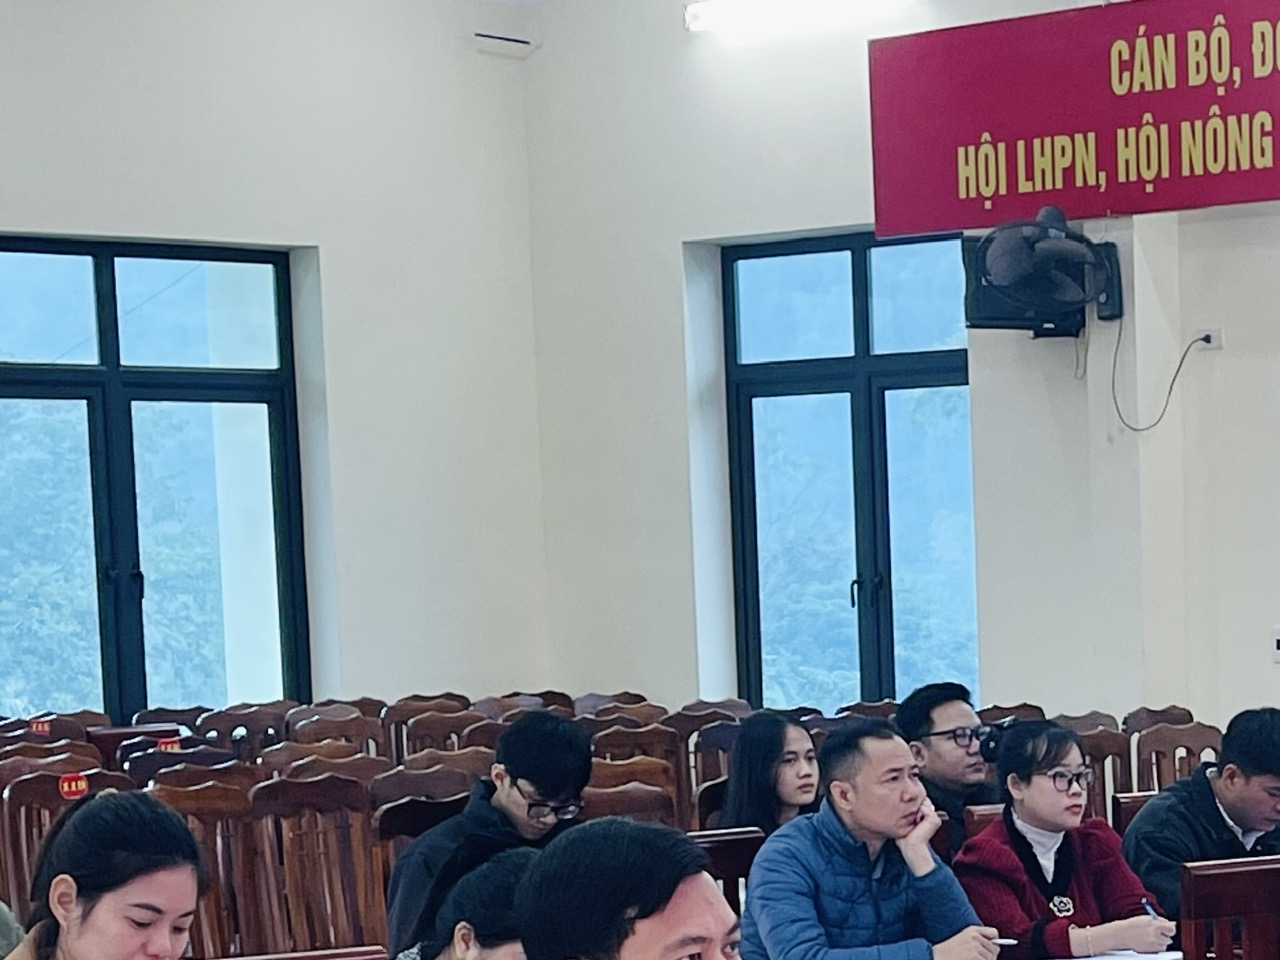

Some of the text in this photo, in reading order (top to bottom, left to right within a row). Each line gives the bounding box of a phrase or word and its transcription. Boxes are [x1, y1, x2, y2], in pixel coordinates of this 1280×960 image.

[1110, 22, 1176, 96] CÁN
[1187, 12, 1242, 98] BỘ,
[957, 131, 1008, 209] HỘI
[1016, 132, 1107, 193] LHPN,
[1117, 112, 1170, 192] HỘI
[1180, 105, 1273, 176] NÔNG
